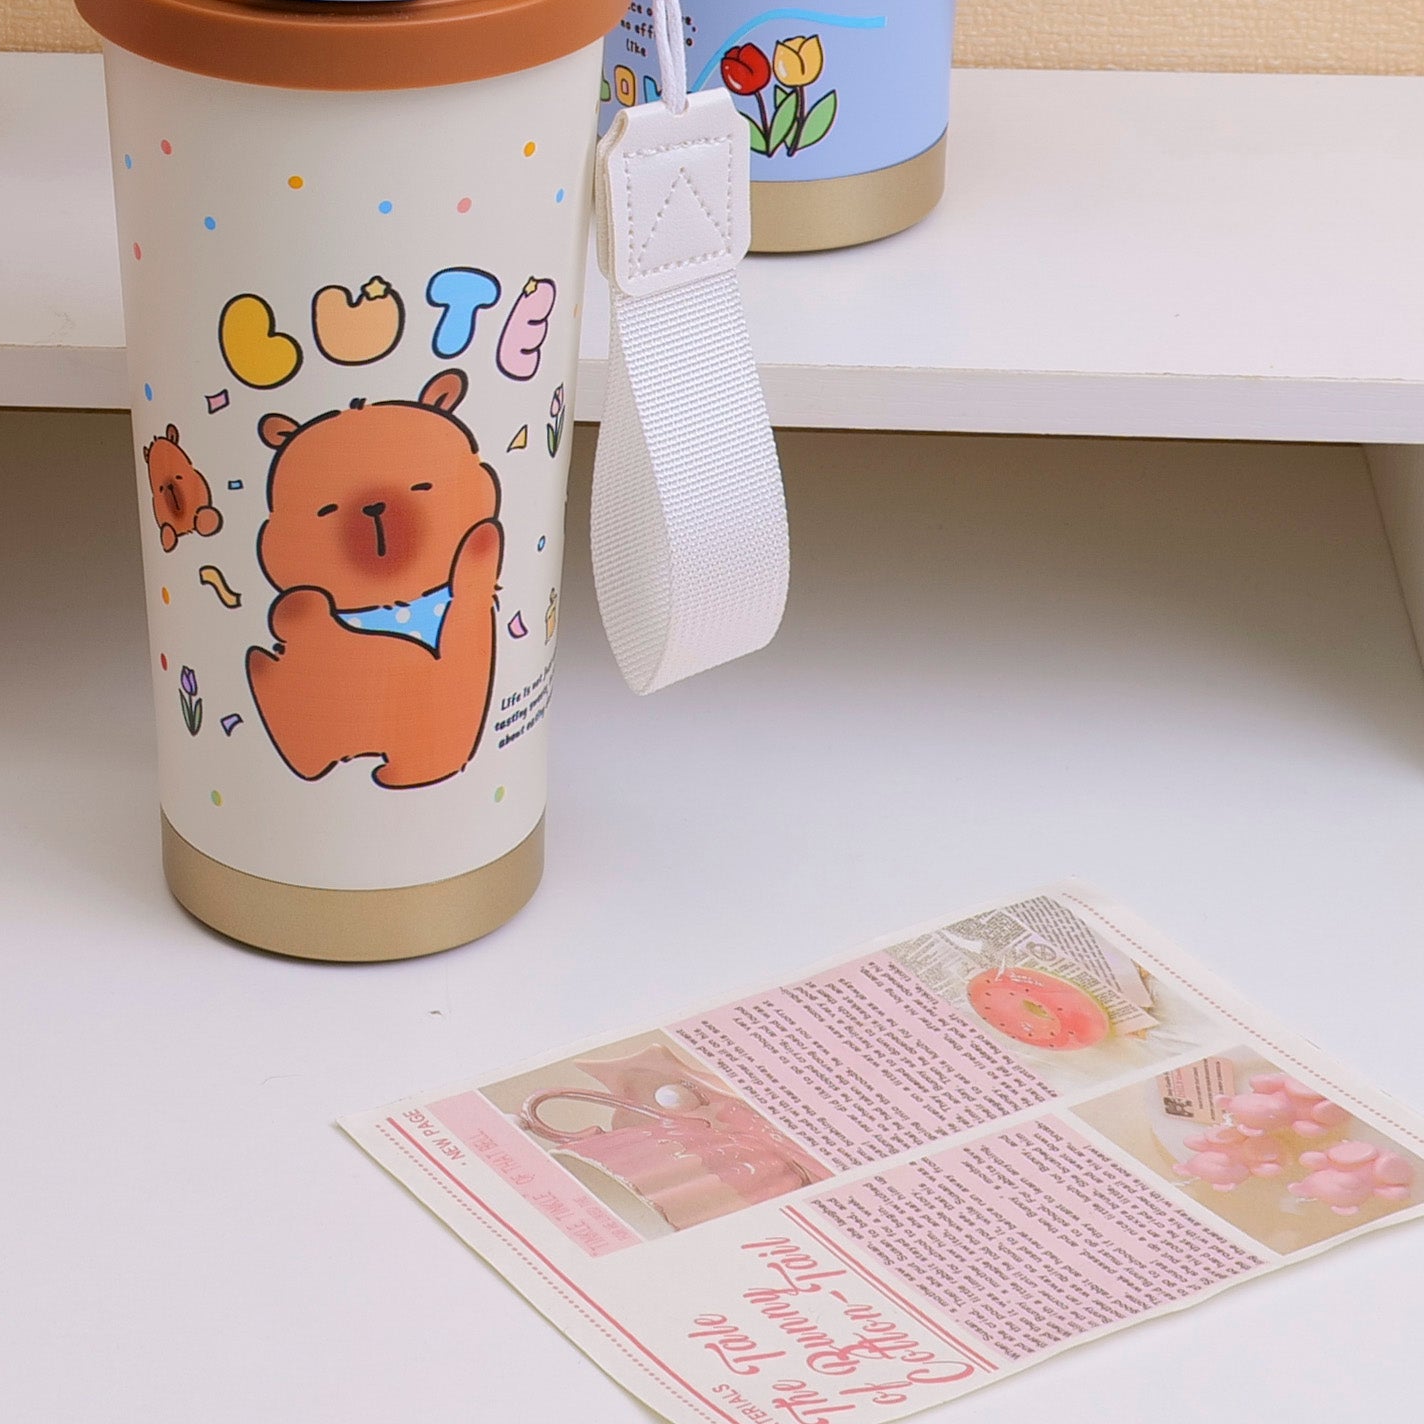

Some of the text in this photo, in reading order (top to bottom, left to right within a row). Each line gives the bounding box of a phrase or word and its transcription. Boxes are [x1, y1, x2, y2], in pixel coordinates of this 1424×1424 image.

[625, 38, 647, 57] like
[402, 1108, 466, 1161] NEW PAGE
[824, 1197, 848, 1211] and
[931, 1211, 964, 1233] whole
[865, 1229, 880, 1239] to
[878, 1225, 897, 1238] for
[903, 1229, 917, 1238] to
[963, 1233, 982, 1246] the
[879, 1239, 908, 1262] Susan
[893, 1238, 929, 1262] stayed
[913, 1238, 947, 1262] school
[978, 1246, 1001, 1262] told
[907, 1262, 928, 1275] put
[924, 1263, 959, 1285] rabbit
[945, 1263, 963, 1275] for
[1001, 1261, 1015, 1272] he
[925, 1275, 944, 1288] she
[959, 1275, 986, 1292] time
[1011, 1271, 1039, 1289] until
[943, 1288, 967, 1308] Then
[957, 1285, 981, 1303] little
[983, 1292, 1007, 1308] was
[1037, 1290, 1069, 1310] corner
[741, 1237, 975, 1383] Cotton-Tail
[980, 1304, 1010, 1321] poor
[1004, 1308, 1019, 1317] it
[1069, 1310, 1087, 1321] the
[743, 1287, 876, 1375] Bunny
[1004, 1321, 1022, 1333] the
[1019, 1317, 1042, 1333] then
[997, 1330, 1017, 1342] she
[688, 1314, 786, 1375] Tale
